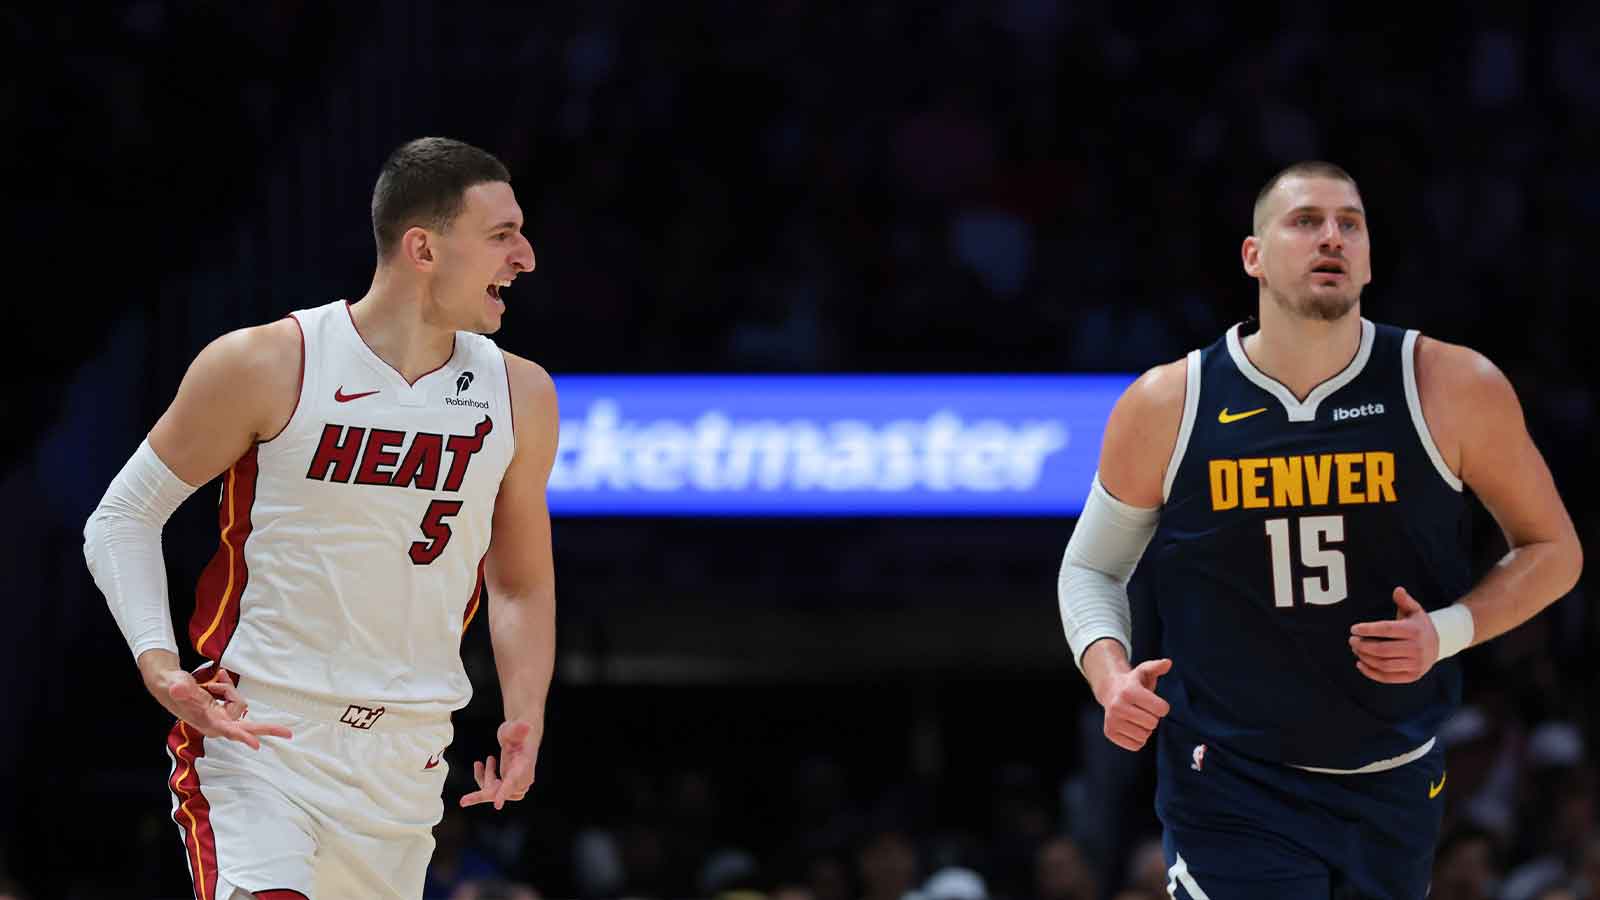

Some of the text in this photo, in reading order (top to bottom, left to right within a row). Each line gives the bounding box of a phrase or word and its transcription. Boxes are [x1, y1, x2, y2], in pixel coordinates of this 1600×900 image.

[445, 397, 489, 409] Robinhood
[1333, 403, 1385, 421] ibotta
[306, 415, 493, 492] HEAT
[1208, 452, 1398, 511] DENVER
[408, 500, 464, 565] 5
[1264, 515, 1348, 608] 15
